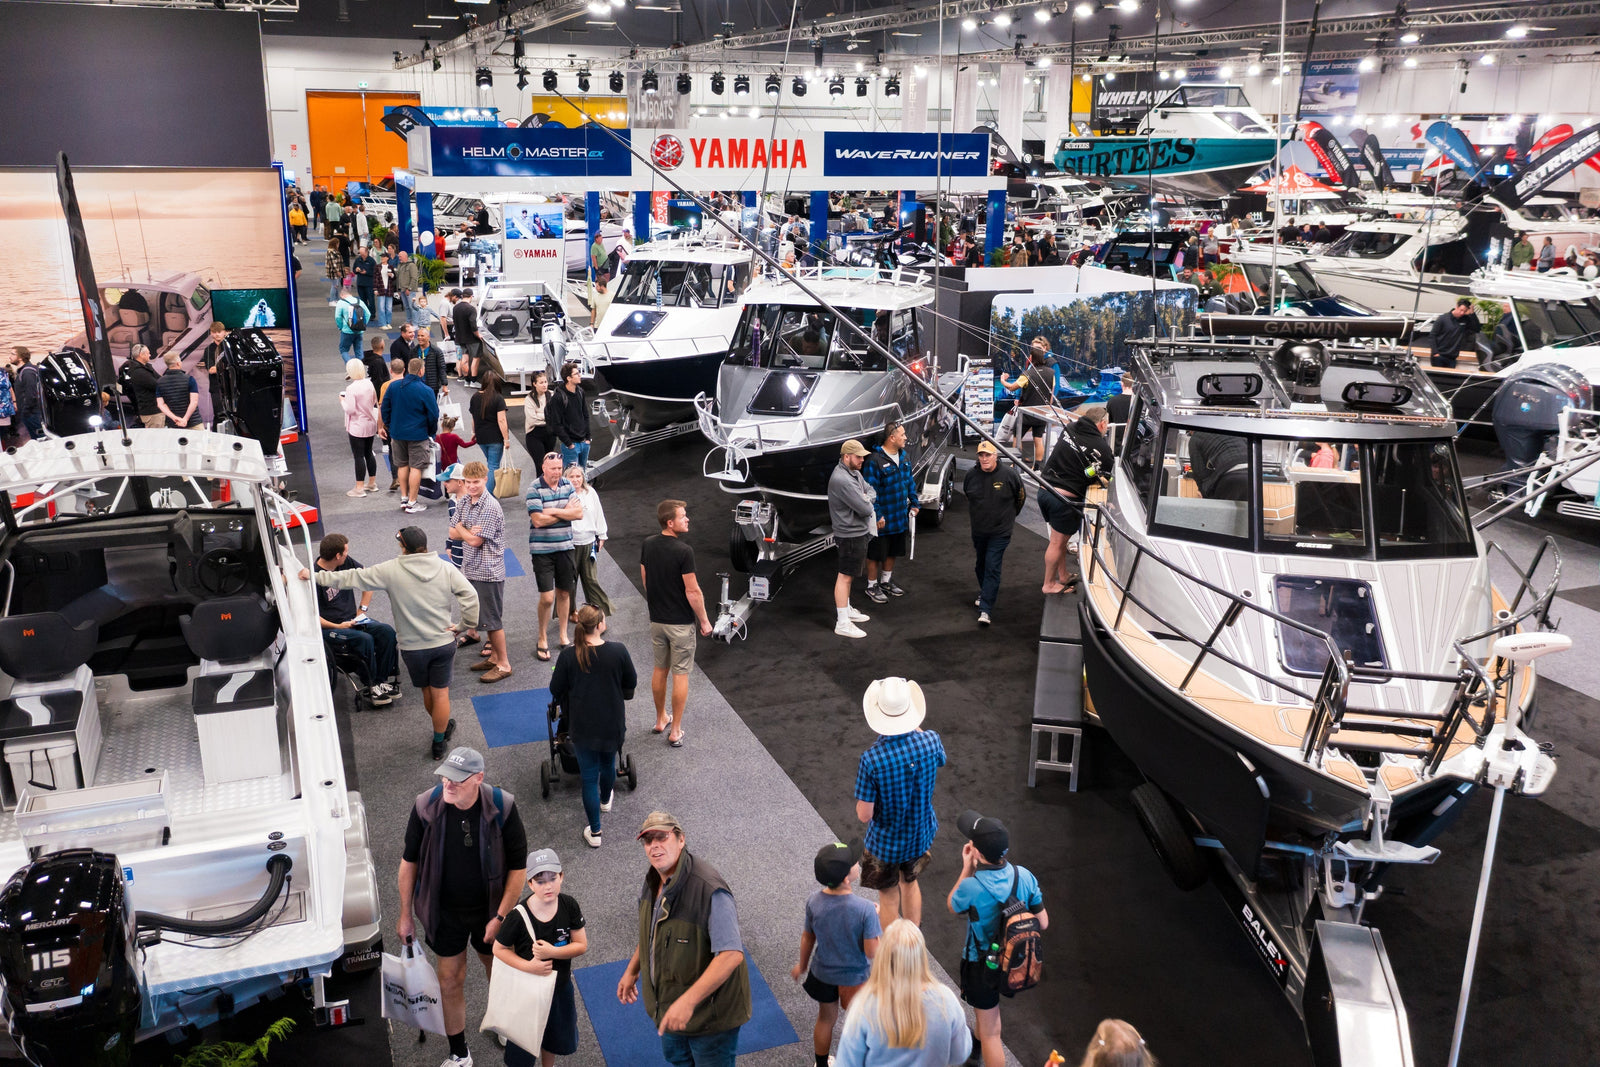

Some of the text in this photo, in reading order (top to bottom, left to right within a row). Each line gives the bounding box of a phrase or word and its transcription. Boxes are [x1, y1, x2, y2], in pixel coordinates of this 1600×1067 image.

[1098, 91, 1138, 106] WHITE
[462, 147, 505, 157] HELM
[525, 147, 587, 157] MASTER
[690, 137, 807, 169] YAMAHA
[1064, 138, 1197, 177] SURTEES
[1514, 130, 1600, 196] EXTREME
[523, 249, 558, 258] YAMAHA
[1264, 321, 1349, 334] GARMIN
[25, 917, 73, 931] MERCURY
[1242, 903, 1287, 971] BALEX
[31, 948, 72, 972] 115
[346, 951, 381, 965] TRAILERS
